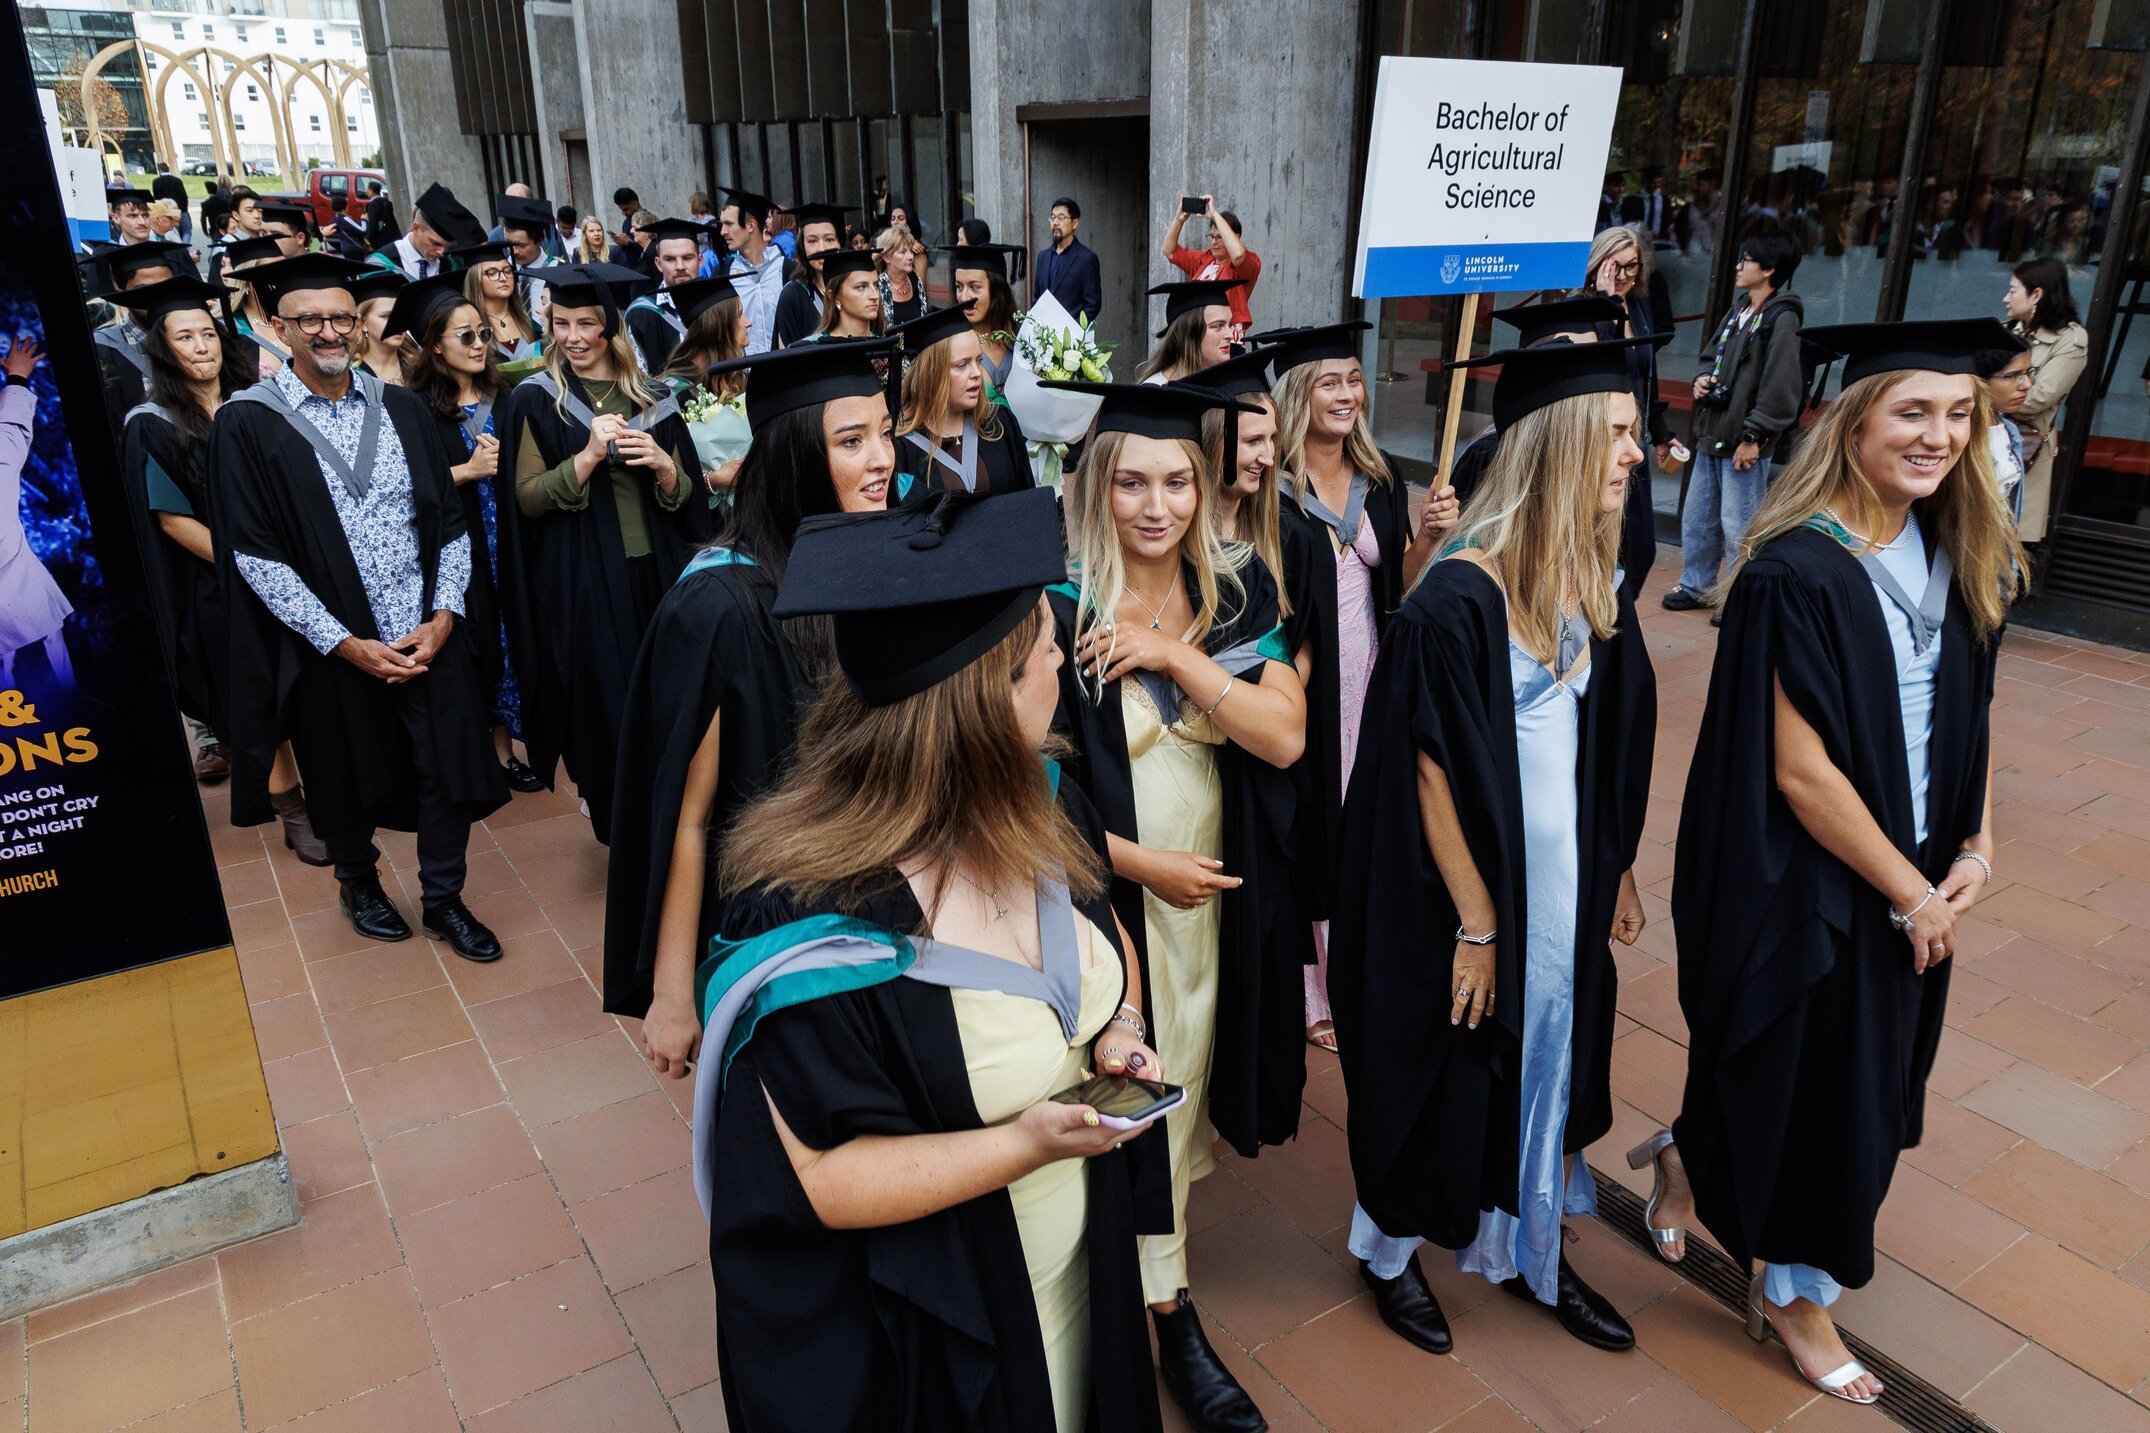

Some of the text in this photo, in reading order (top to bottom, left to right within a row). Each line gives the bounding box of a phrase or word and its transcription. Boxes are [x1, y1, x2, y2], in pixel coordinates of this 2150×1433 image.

[1435, 102, 1569, 132] Bachelor of
[1427, 143, 1564, 176] Agricultural
[1445, 182, 1536, 209] Science
[1464, 264, 1520, 274] UNIVERSITY
[1465, 256, 1504, 265] LINCOLN
[0, 689, 41, 727] &
[36, 784, 65, 799] ON
[1, 795, 99, 825] DON'T CRY
[12, 828, 26, 841] A
[28, 816, 84, 837] NIGHT
[0, 841, 44, 860] ORE!
